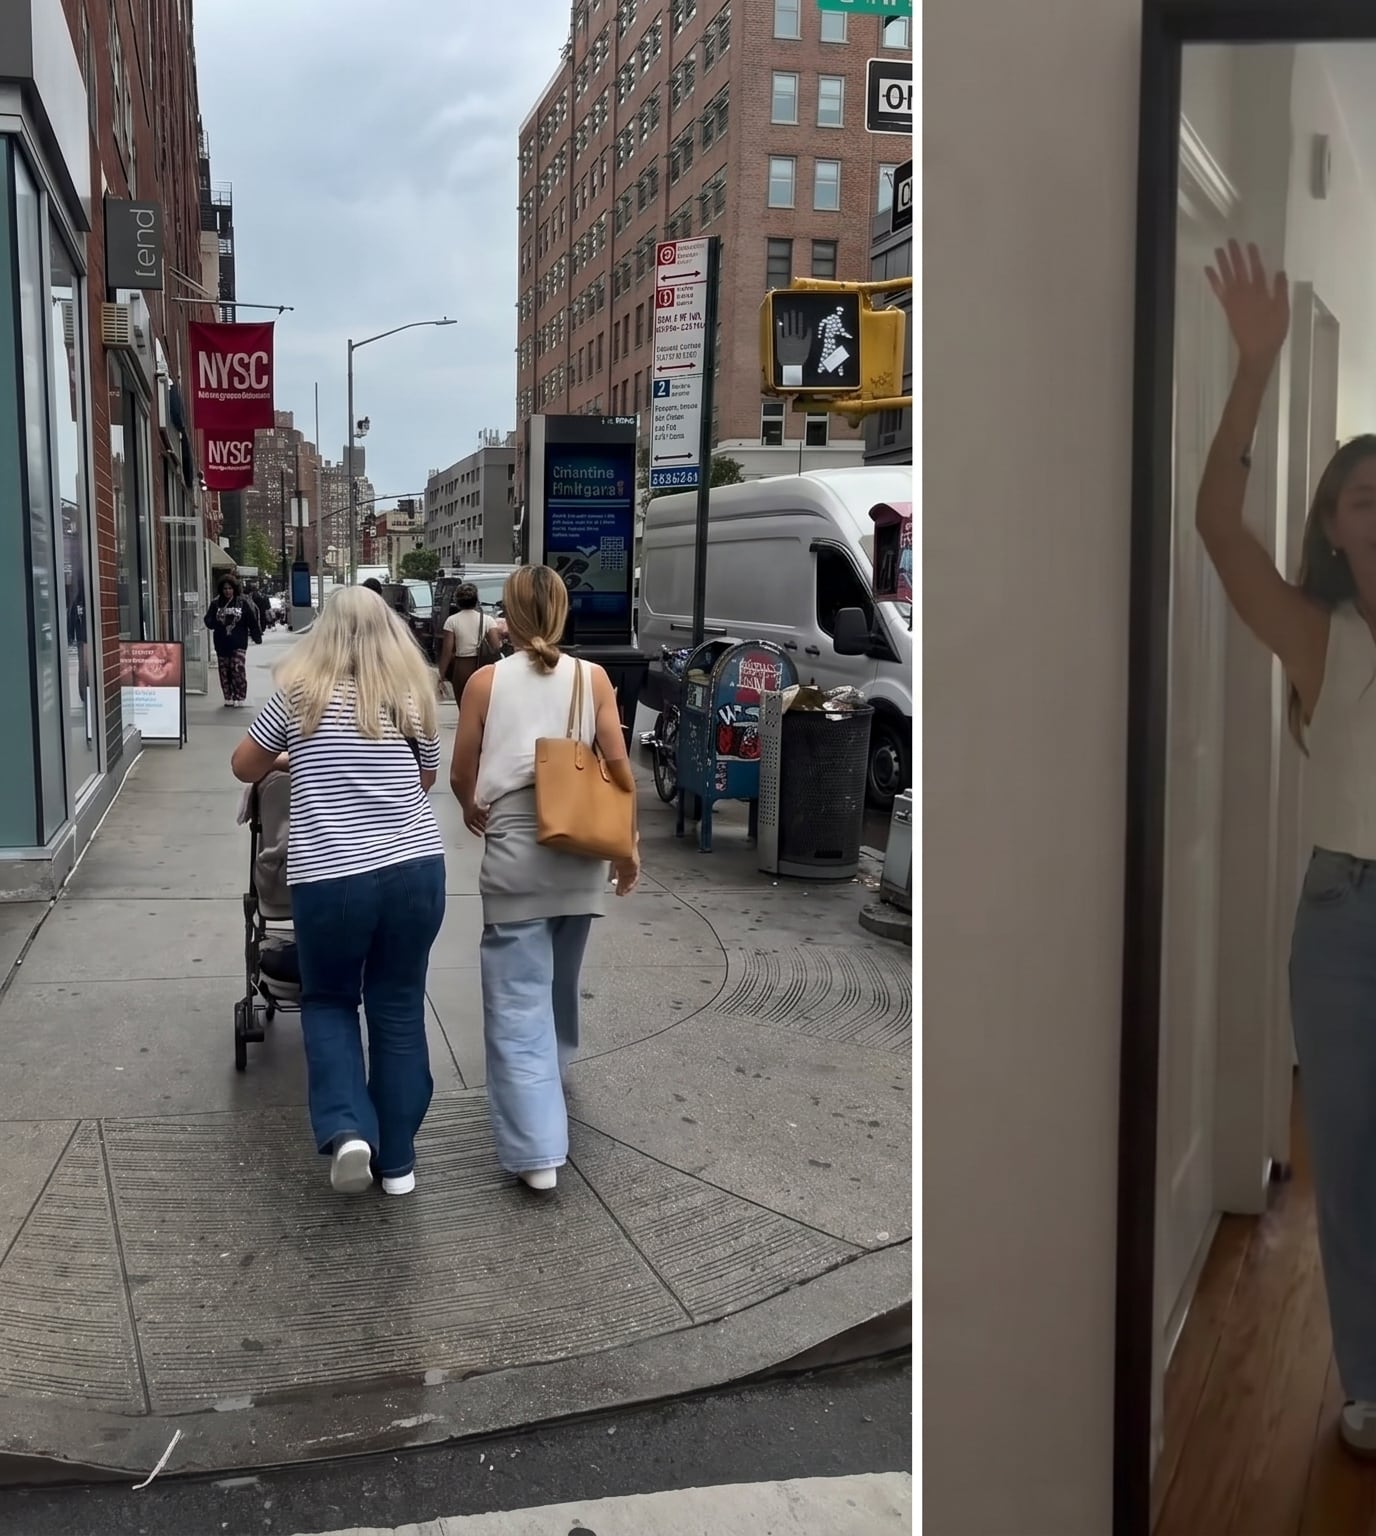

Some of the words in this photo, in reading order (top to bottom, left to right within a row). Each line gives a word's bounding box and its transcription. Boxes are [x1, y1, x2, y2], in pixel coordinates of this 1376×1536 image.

[198, 350, 269, 390] NYSC
[657, 381, 666, 396] 2
[208, 440, 253, 465] NYSC
